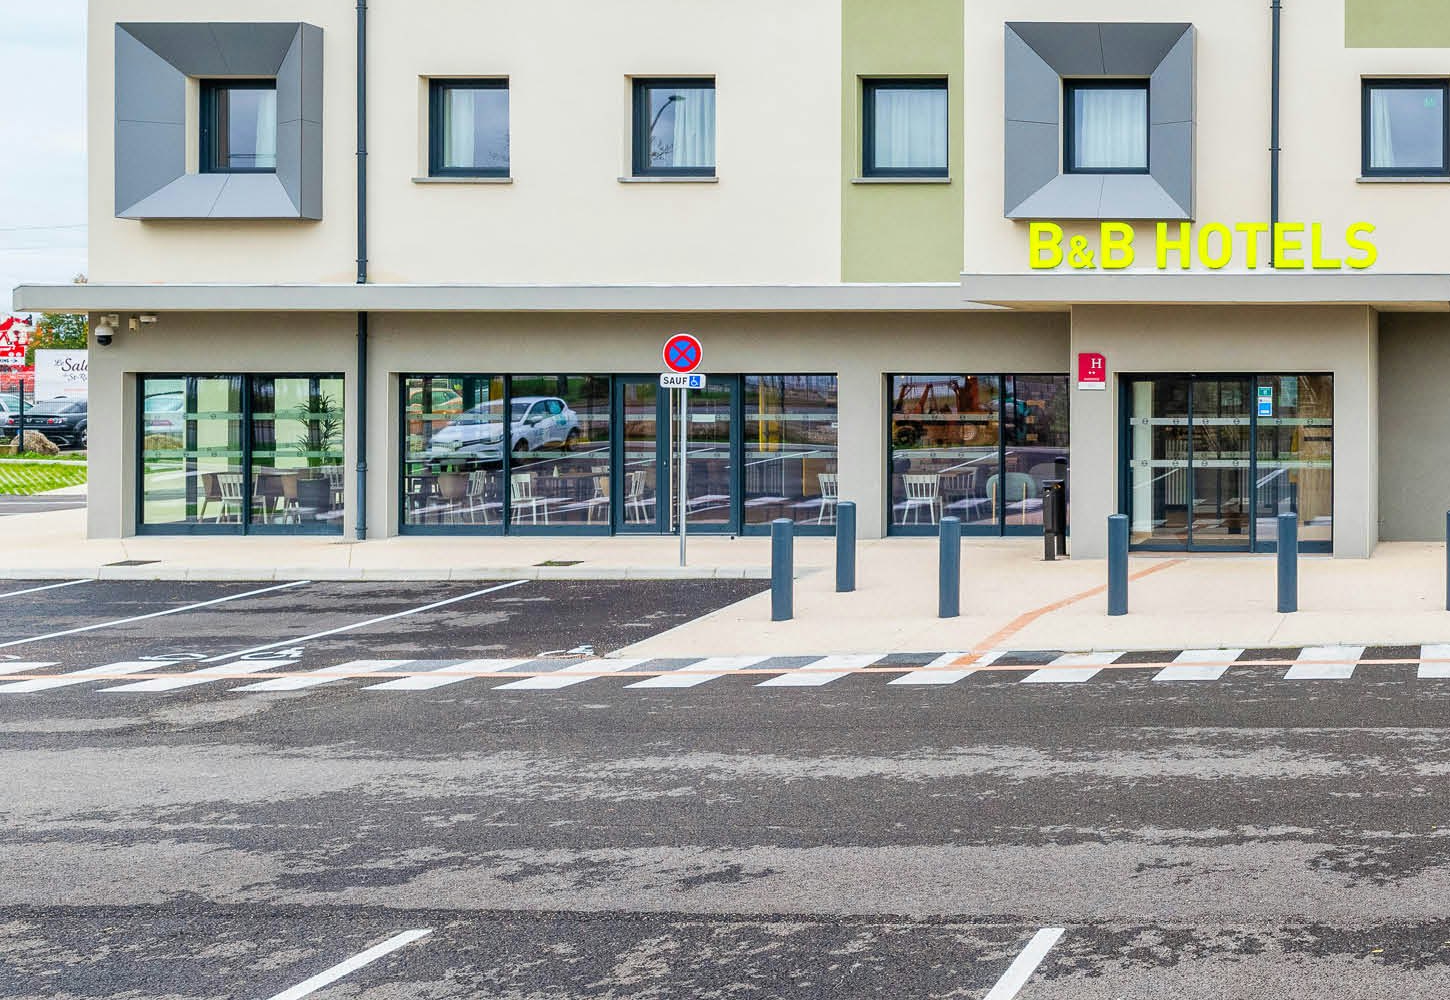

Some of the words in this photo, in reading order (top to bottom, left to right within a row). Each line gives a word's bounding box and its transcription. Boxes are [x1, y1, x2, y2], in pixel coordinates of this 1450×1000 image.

[1029, 222, 1135, 269] B&B
[1156, 222, 1378, 269] HOTELS
[1091, 358, 1102, 369] H
[663, 376, 688, 385] SAUF
